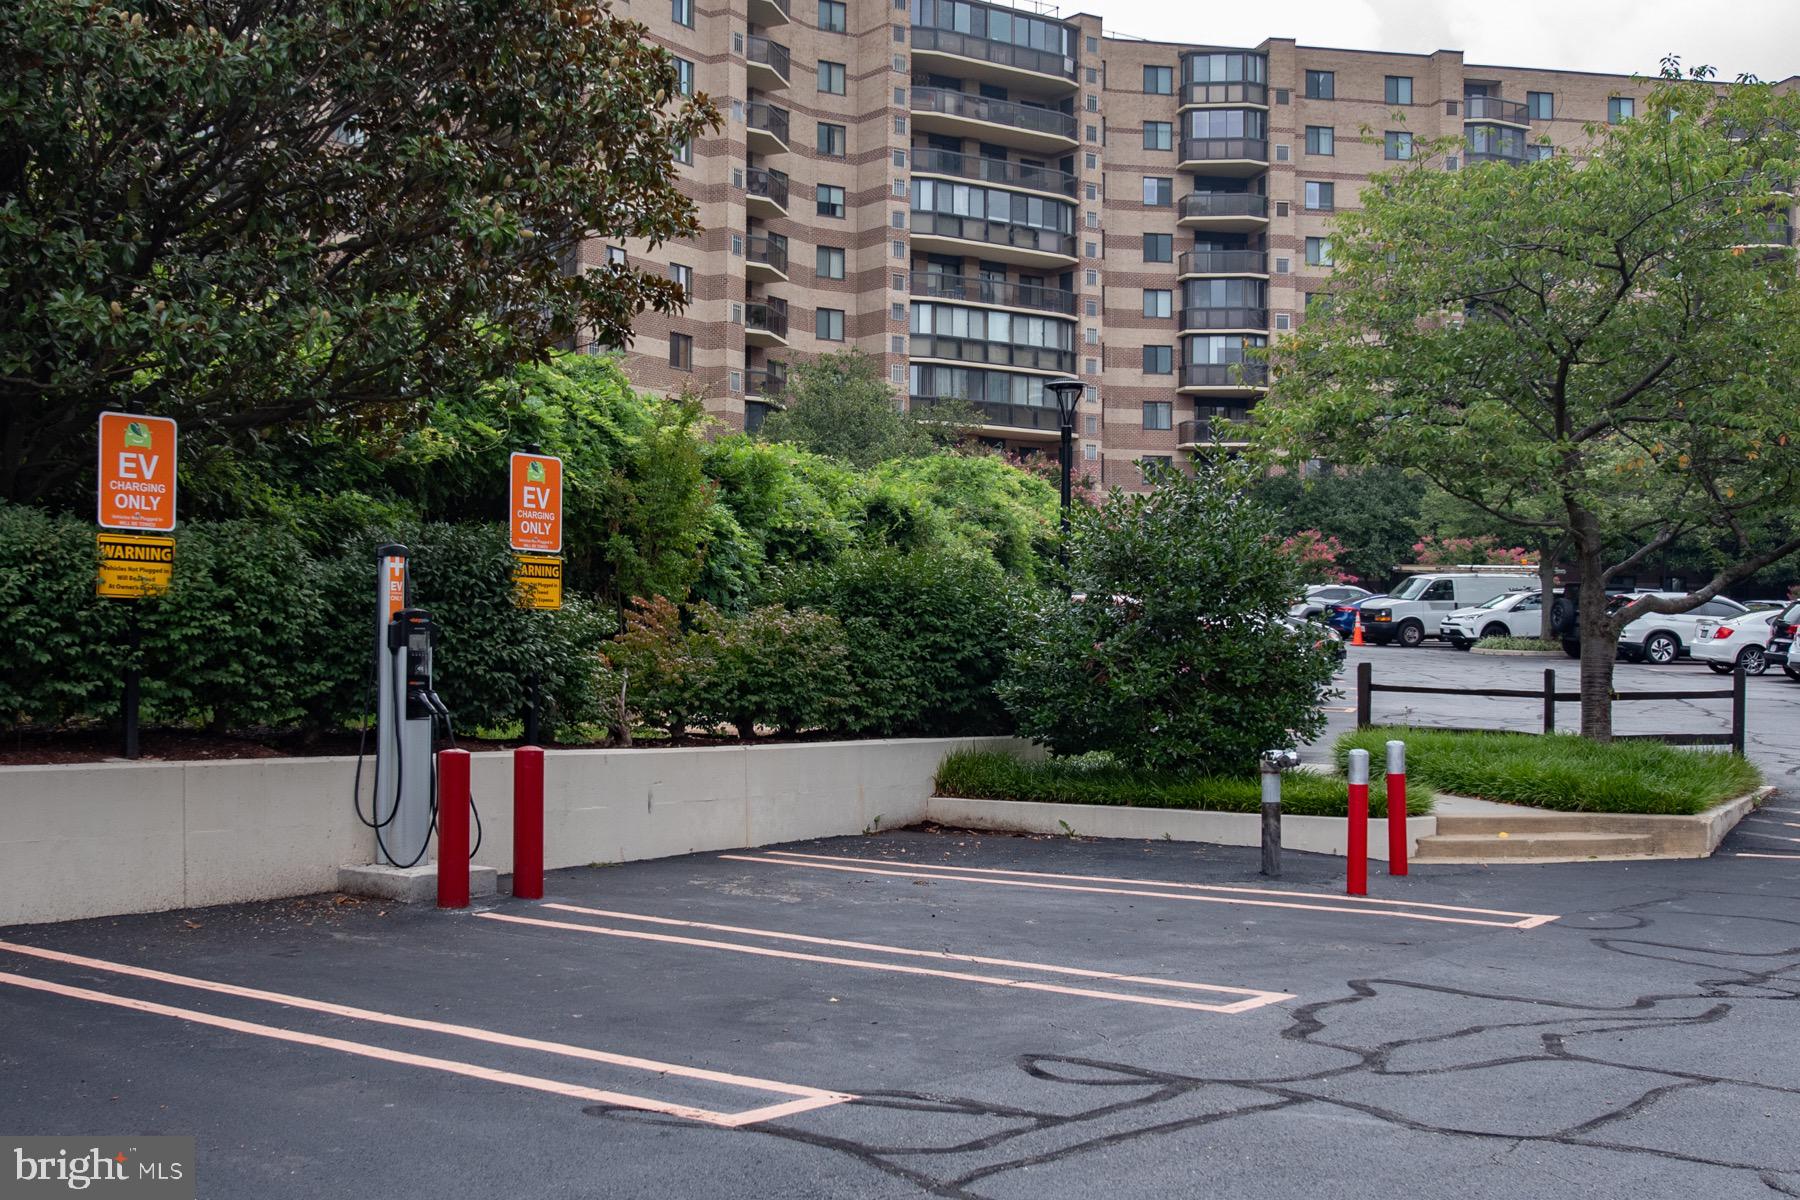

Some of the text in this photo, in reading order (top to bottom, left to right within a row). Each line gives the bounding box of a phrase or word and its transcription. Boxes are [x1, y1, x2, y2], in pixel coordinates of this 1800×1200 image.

[119, 452, 159, 480] EV
[110, 480, 166, 493] CHARGING
[115, 494, 161, 510] ONLY
[523, 486, 550, 509] EV
[517, 510, 555, 520] CHARGING
[521, 521, 551, 535] ONLY
[103, 544, 172, 562] WARNING
[390, 581, 403, 591] EV
